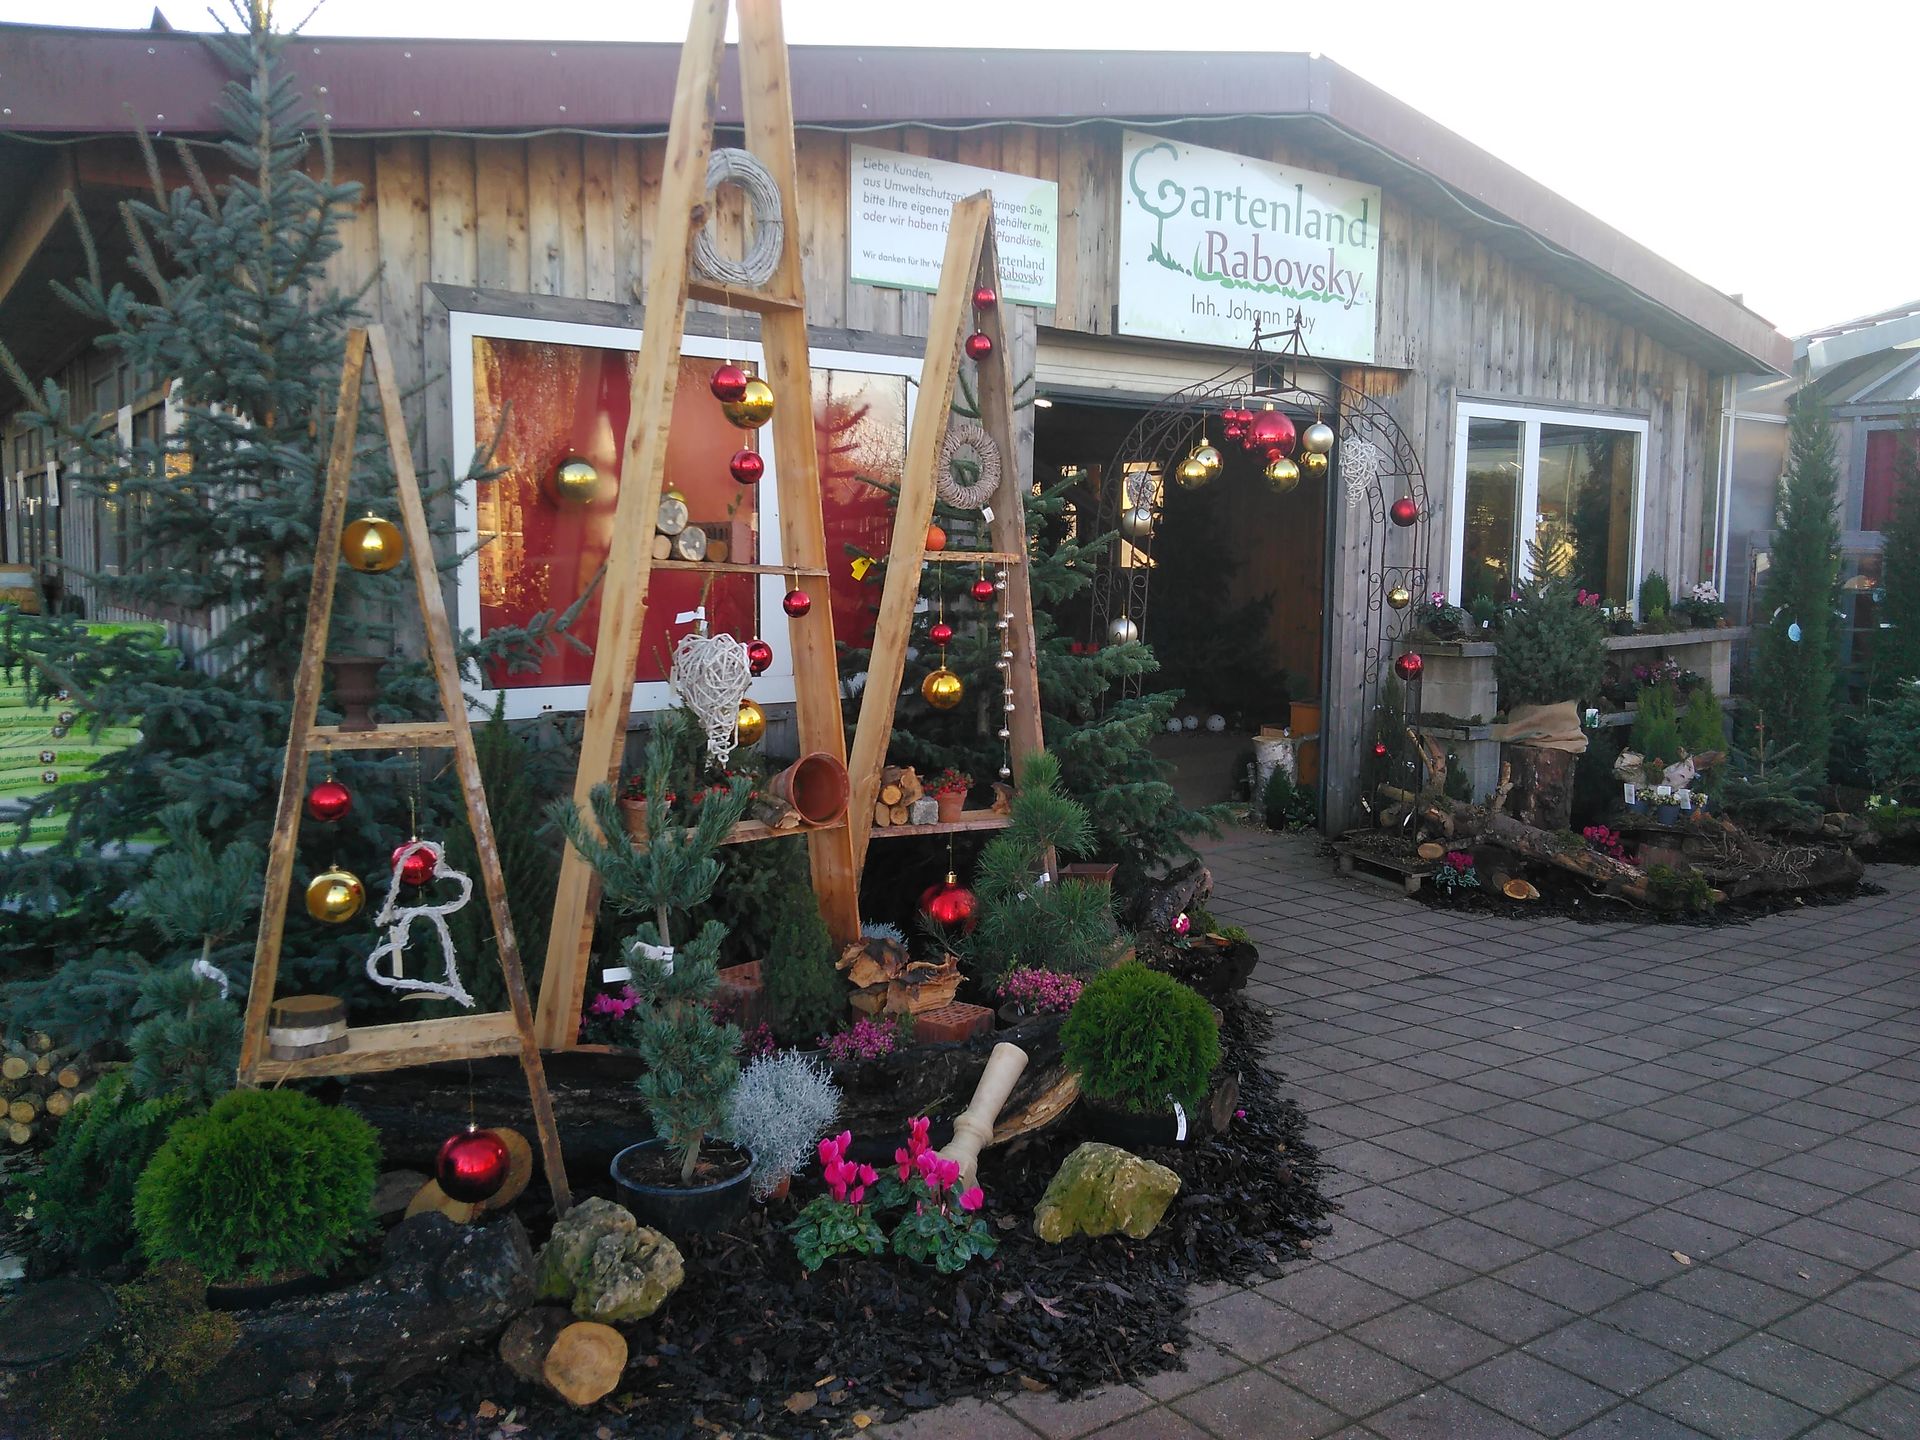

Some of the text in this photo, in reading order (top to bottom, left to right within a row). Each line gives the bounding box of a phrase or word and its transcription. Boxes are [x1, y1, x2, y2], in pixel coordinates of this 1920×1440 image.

[863, 157, 933, 181] Liebe Kunden,
[863, 177, 881, 188] aus
[993, 197, 1027, 214] bringen
[1029, 204, 1043, 216] Sie
[863, 192, 1050, 234] bitte Ihre eigenen behälter mit,
[1129, 142, 1369, 249] Gartenland
[863, 210, 886, 223] oder
[889, 215, 905, 226] wir
[908, 216, 938, 231] haben
[996, 230, 1044, 248] Pfandkiste.
[862, 249, 876, 260] Wir
[878, 252, 906, 264] danken
[908, 255, 919, 266] für
[920, 258, 930, 268] Ihr
[999, 266, 1044, 287] Rabovsky
[1205, 230, 1363, 310] Rabovsky
[1192, 293, 1316, 335] Inh. Johann Puy
